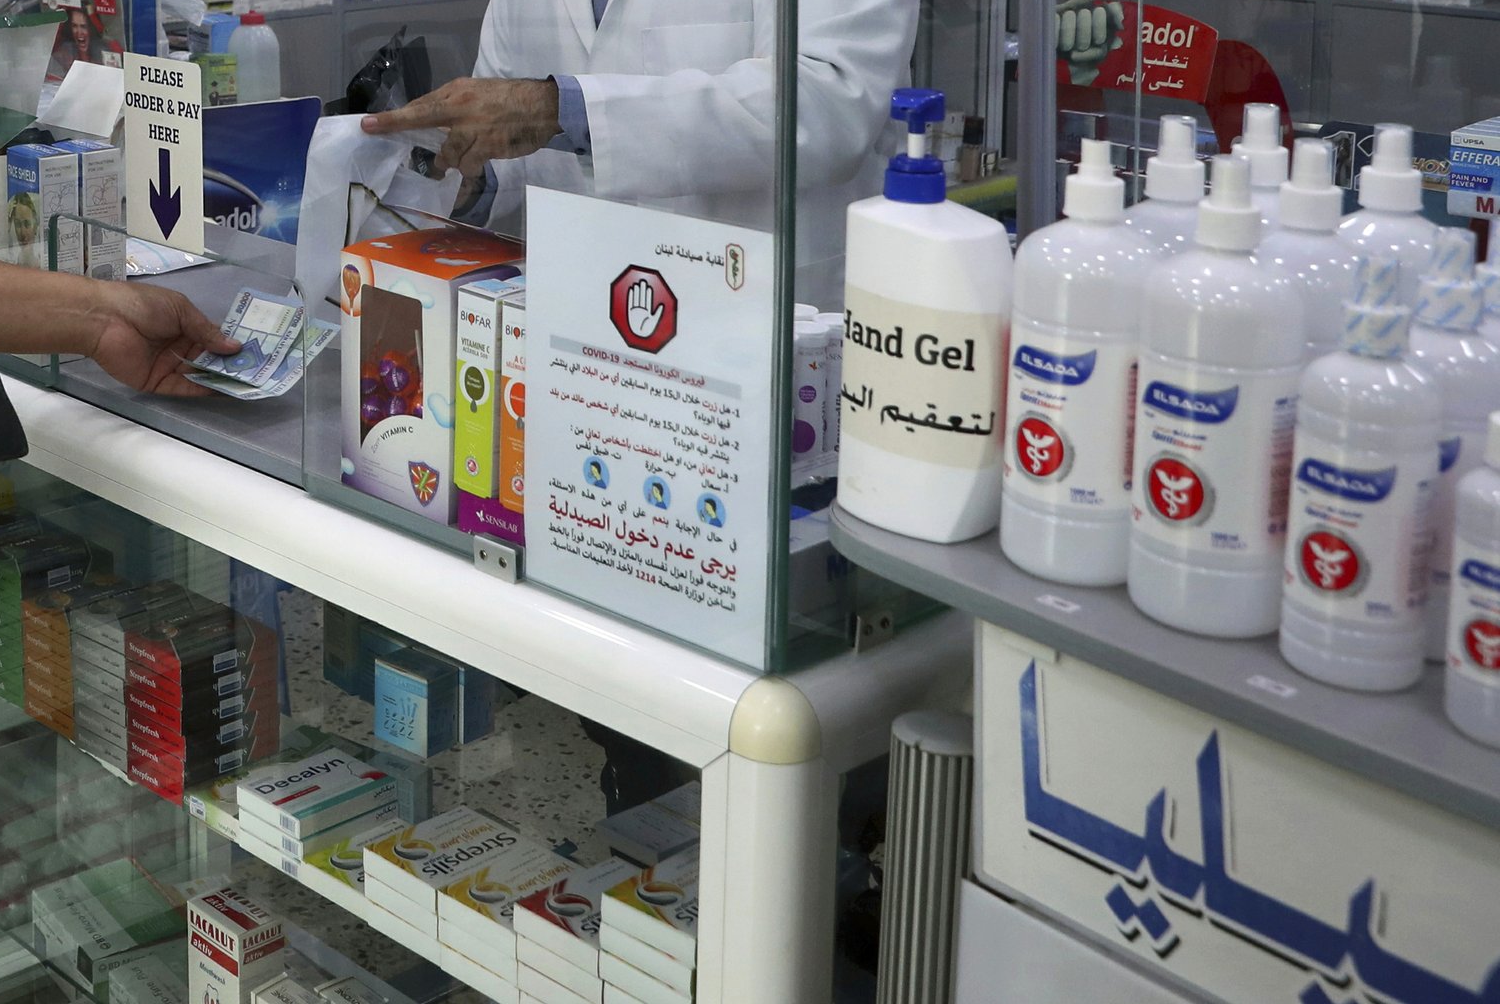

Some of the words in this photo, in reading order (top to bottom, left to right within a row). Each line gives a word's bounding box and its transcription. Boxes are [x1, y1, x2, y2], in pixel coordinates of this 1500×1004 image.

[1141, 20, 1194, 49] adol
[140, 66, 184, 88] PLEASE
[1148, 76, 1184, 91] على
[126, 92, 164, 114] ORDER
[167, 100, 174, 114] &
[178, 104, 200, 120] PAY
[149, 124, 180, 144] HERE
[1452, 151, 1500, 166] EFFERA
[21, 169, 37, 183] SHIELD
[1452, 180, 1475, 188] FEVER
[215, 204, 256, 229] adol
[655, 244, 673, 256] لبنان
[461, 336, 483, 353] VITAMINE
[582, 346, 619, 363] COVID-19
[914, 333, 975, 371] Gel
[1021, 353, 1079, 378] ELSADA
[1153, 389, 1219, 416] ELSADA
[880, 403, 996, 436] لتعقيم
[380, 427, 406, 441] VITAMIN
[485, 513, 518, 533] SENSILAB
[549, 495, 610, 531] الصيدلية
[615, 520, 659, 549] دخول
[663, 541, 695, 561] عدم
[636, 569, 656, 585] 1214
[701, 556, 737, 582] يرجى
[129, 642, 155, 662] Strepfresh
[129, 669, 156, 688] Strepfresh
[130, 694, 156, 713] Strepfresh
[132, 742, 158, 763] Strepfresh
[255, 757, 345, 795] Decalyn
[422, 832, 517, 878] Strepsils
[190, 910, 235, 952] LACALUT
[193, 938, 212, 956] aktiv
